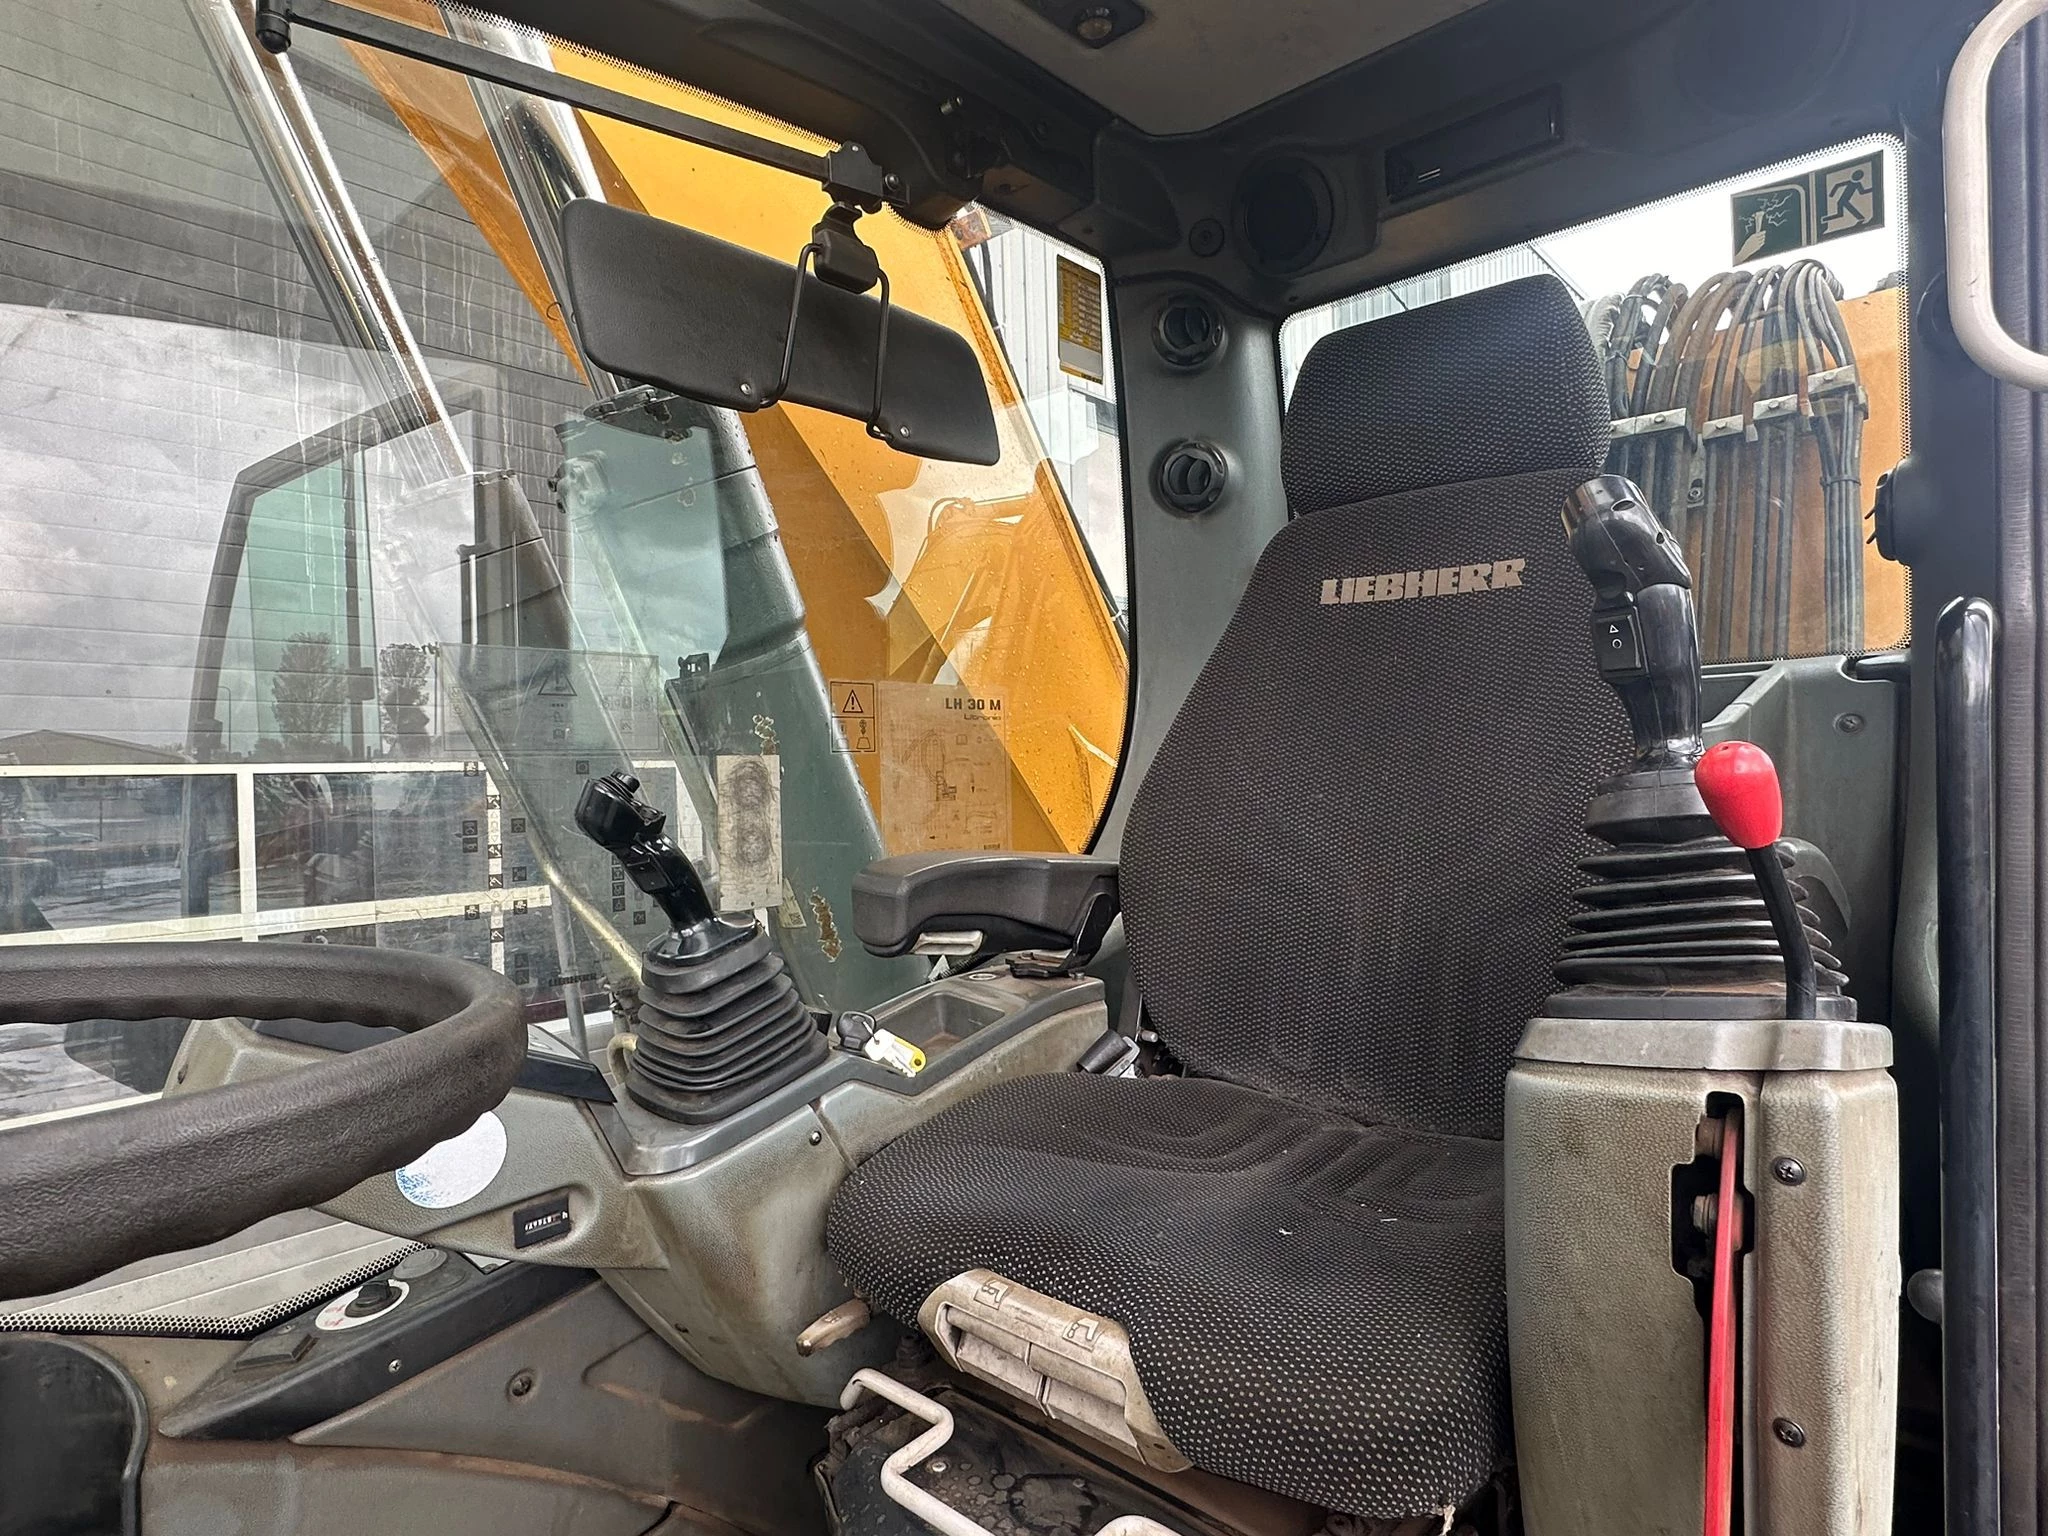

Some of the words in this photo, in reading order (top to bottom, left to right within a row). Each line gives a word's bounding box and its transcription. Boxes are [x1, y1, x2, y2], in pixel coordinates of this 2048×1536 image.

[1320, 558, 1526, 605] LIEBHERR
[945, 697, 963, 710] LH
[967, 698, 985, 711] 30
[989, 699, 1001, 711] M
